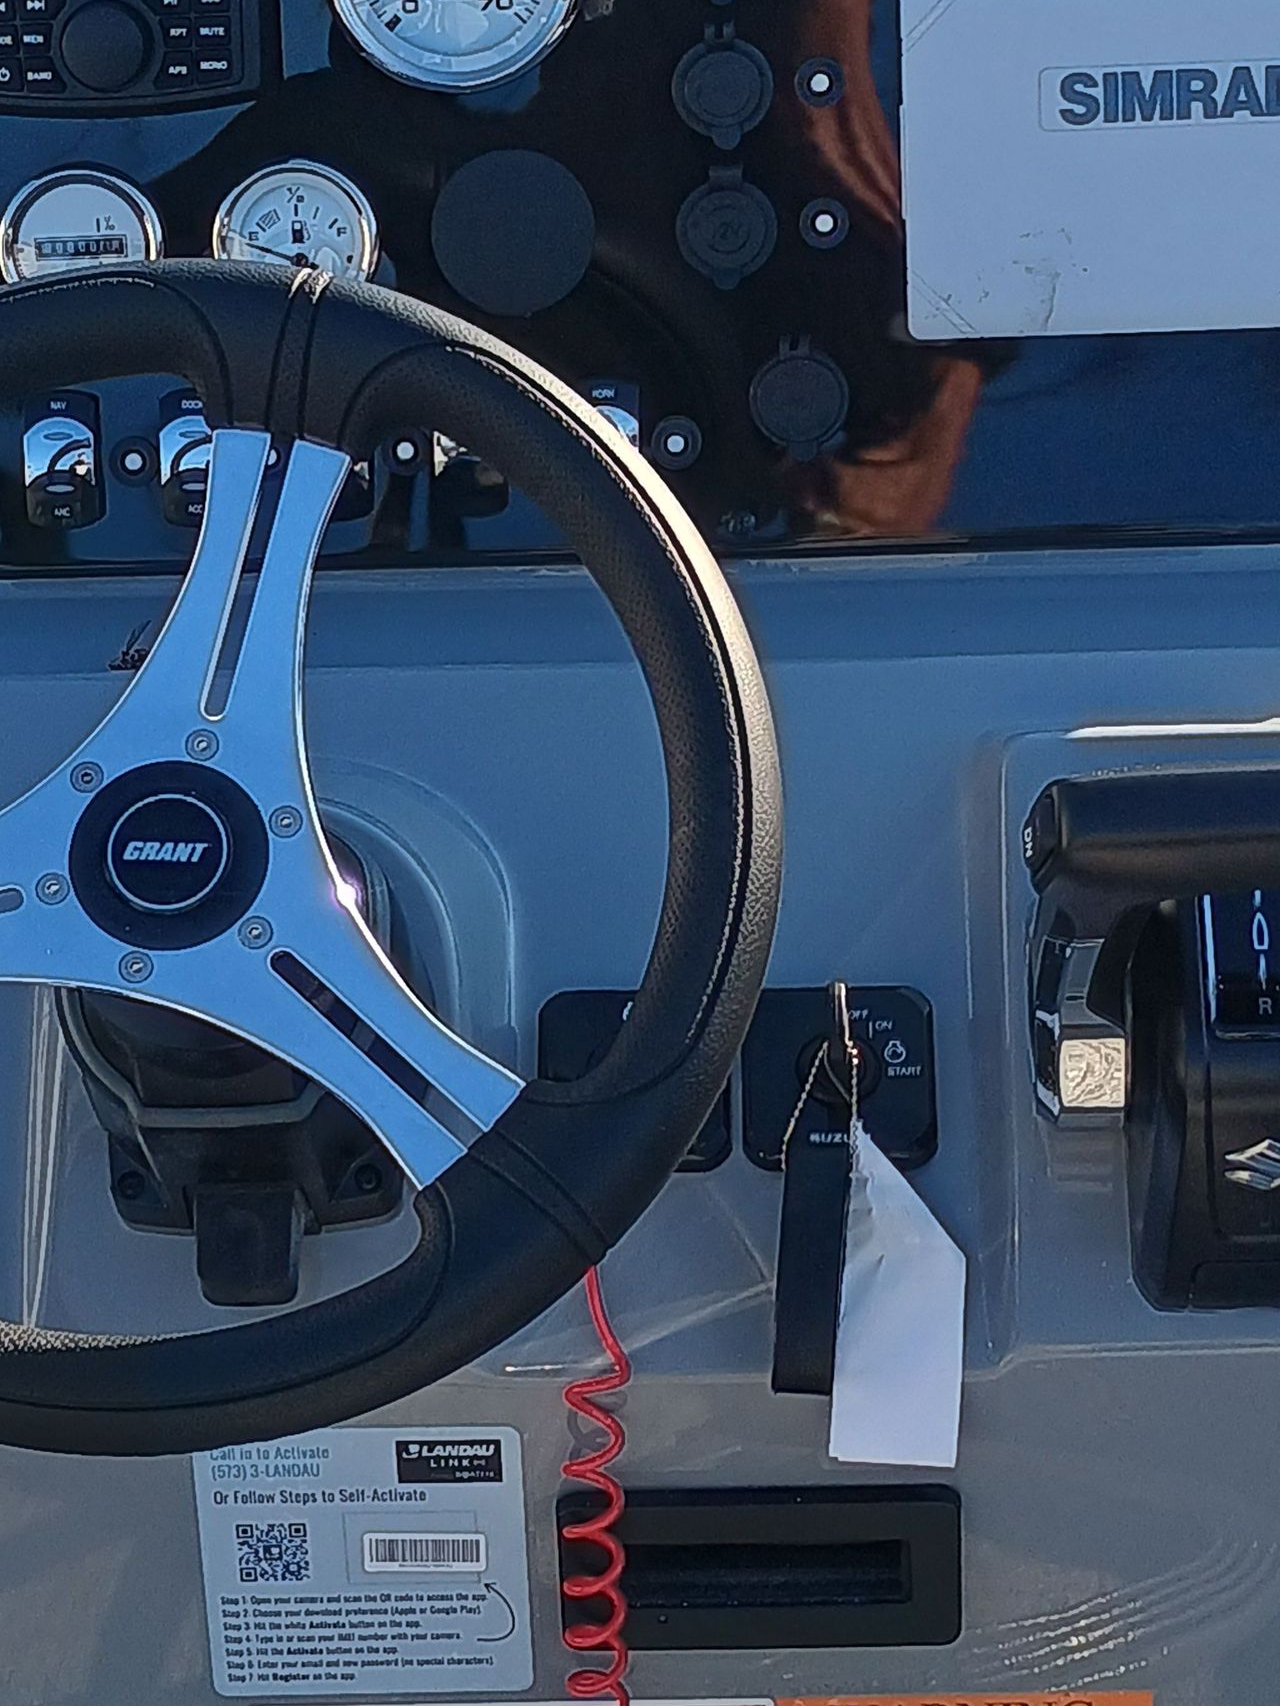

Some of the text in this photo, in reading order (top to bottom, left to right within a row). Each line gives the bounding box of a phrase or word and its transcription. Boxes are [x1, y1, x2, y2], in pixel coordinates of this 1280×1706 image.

[199, 26, 225, 36] MUTE
[248, 231, 260, 241] E
[336, 227, 347, 237] F
[50, 401, 67, 410] NAV
[123, 841, 208, 862] GRANT
[1259, 997, 1272, 1014] R
[849, 1009, 868, 1019] OFF
[875, 1021, 893, 1031] ON
[888, 1066, 921, 1076] START
[257, 1447, 270, 1460] to
[274, 1446, 329, 1460] Activate
[422, 1444, 495, 1456] LANDAU
[431, 1459, 470, 1467] LINK
[212, 1463, 320, 1481] (573) 3-LANDAU
[214, 1488, 427, 1506] Or Follow Steps to Self-Activate
